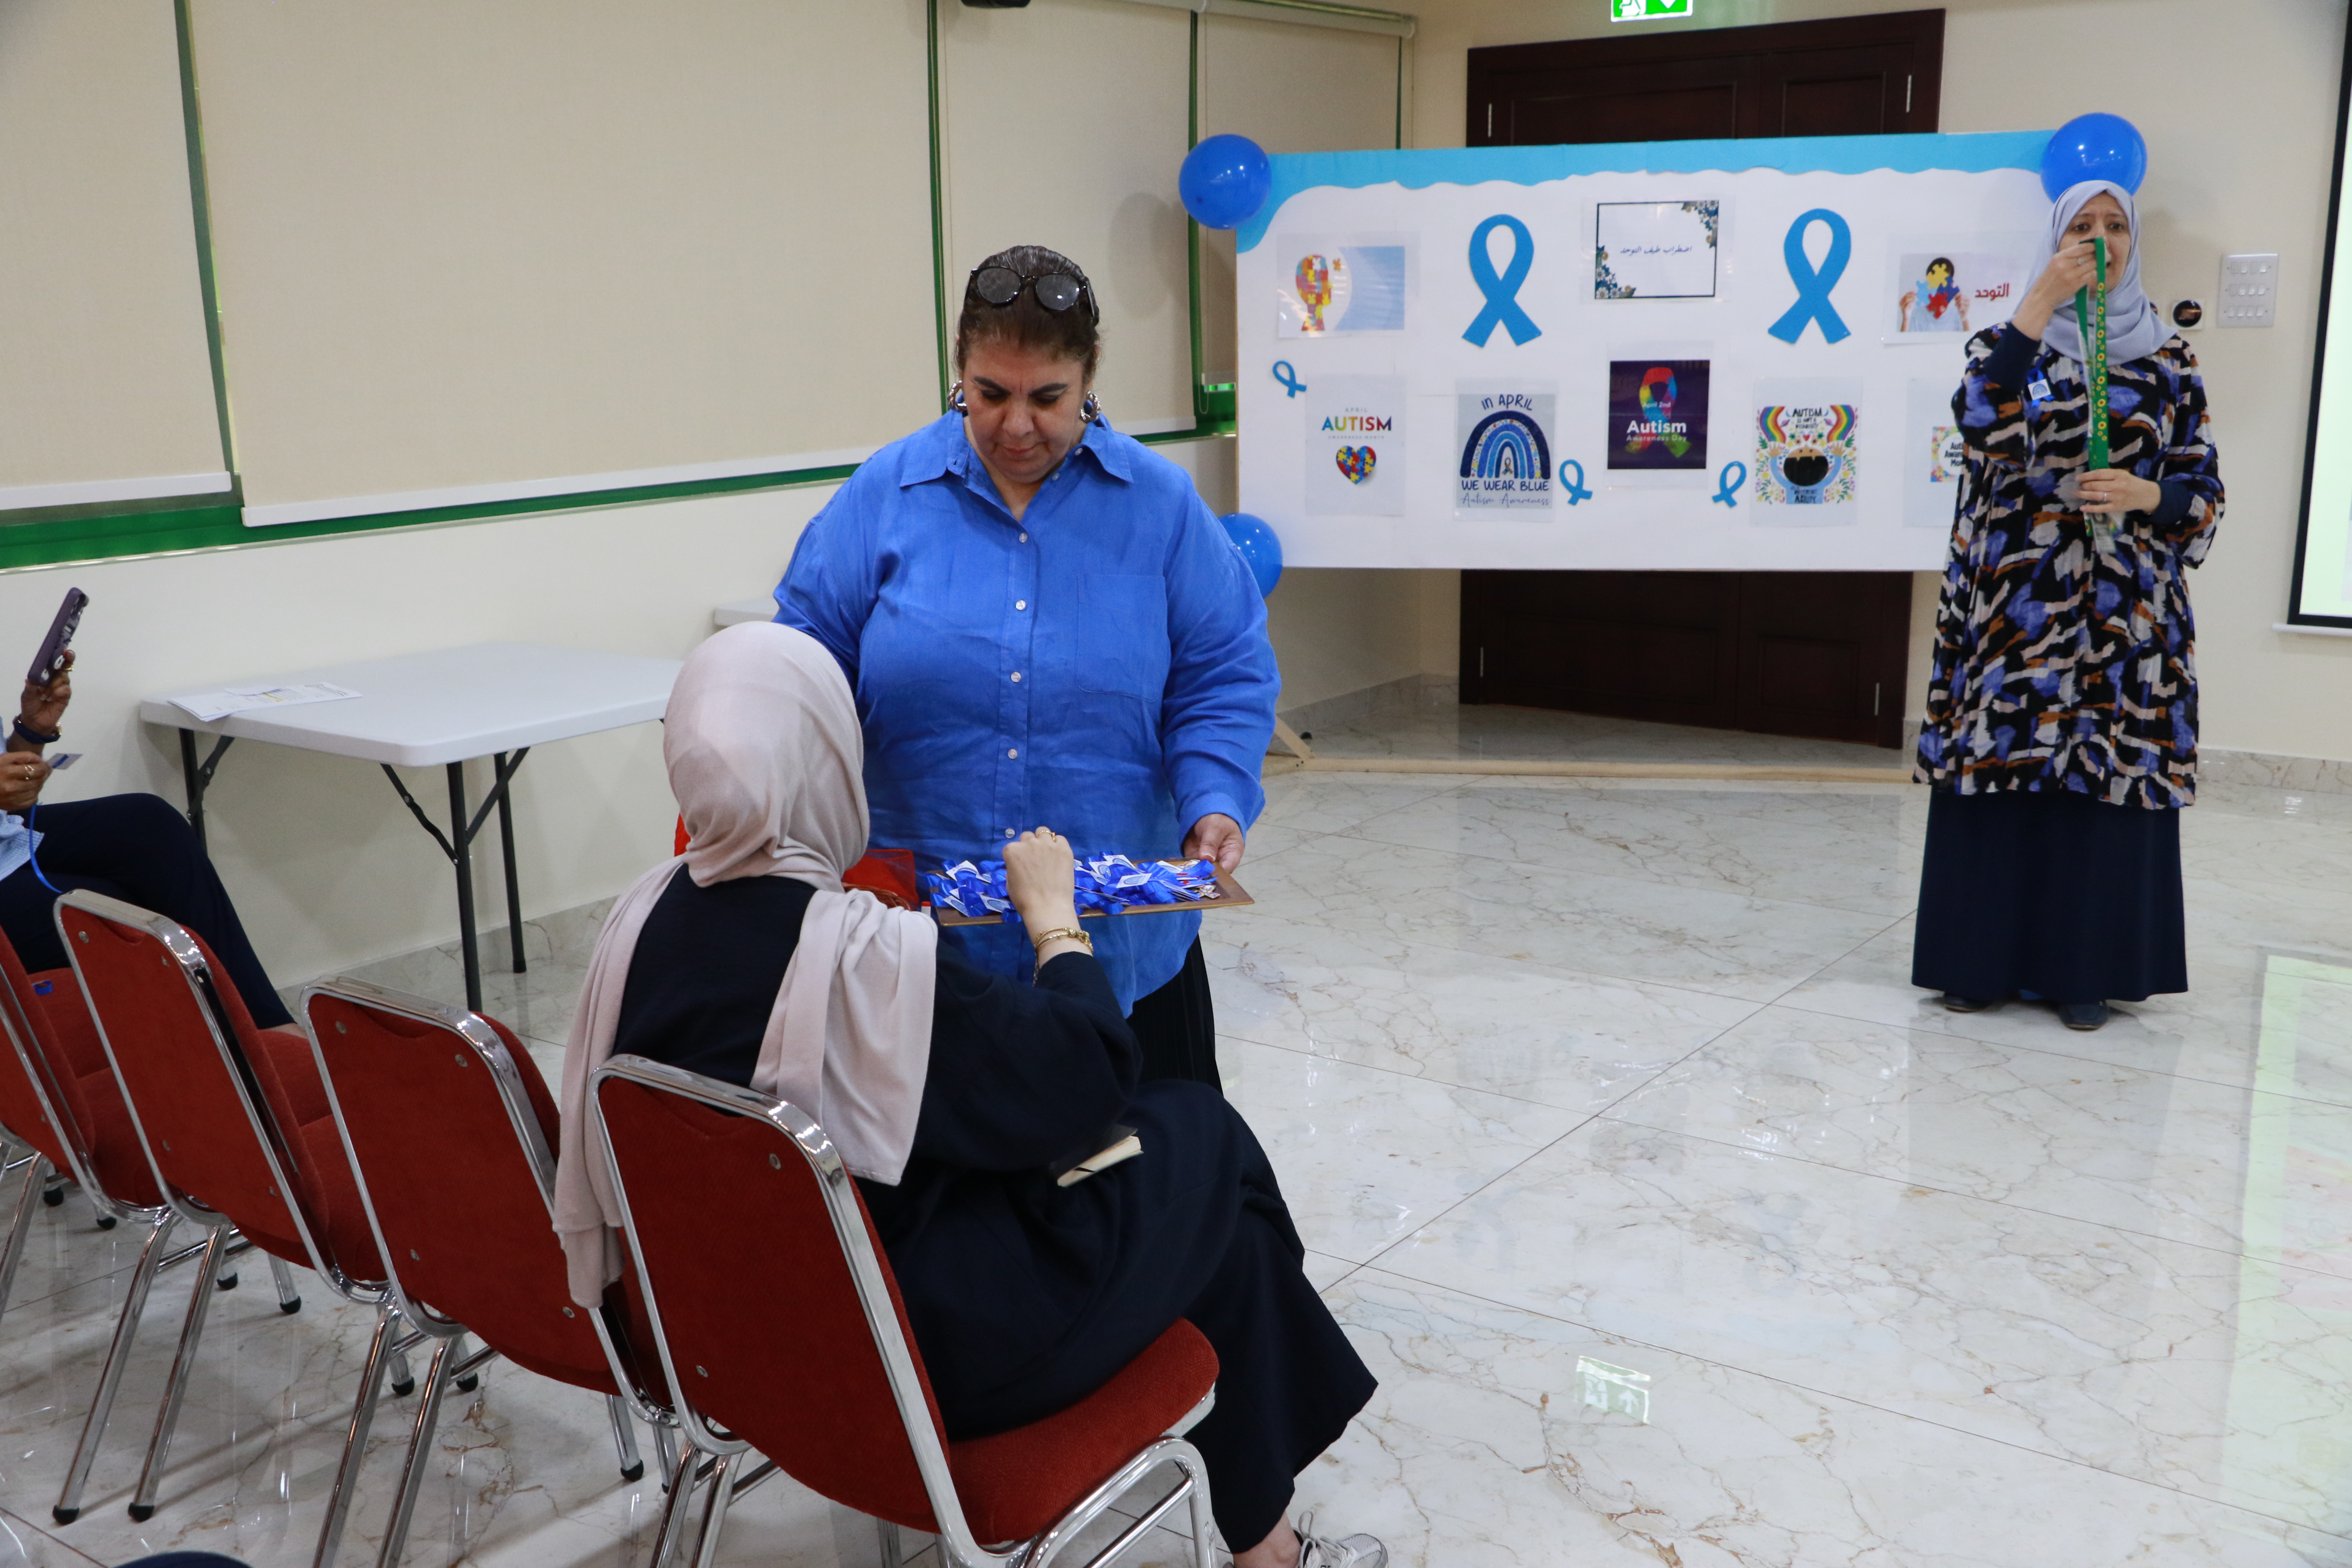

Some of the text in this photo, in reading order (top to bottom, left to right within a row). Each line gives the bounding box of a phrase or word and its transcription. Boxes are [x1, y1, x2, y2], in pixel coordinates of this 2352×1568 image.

[1975, 282, 2009, 301] التوحد
[1499, 394, 1532, 411] APRIL
[1792, 407, 1822, 418] AUTISM
[1321, 416, 1392, 431] AUTISM
[1626, 420, 1687, 434] Autism
[1672, 434, 1687, 442] Day
[1462, 480, 1550, 491] WE WEAR BLUE
[1462, 492, 1549, 508] Autism Awareness
